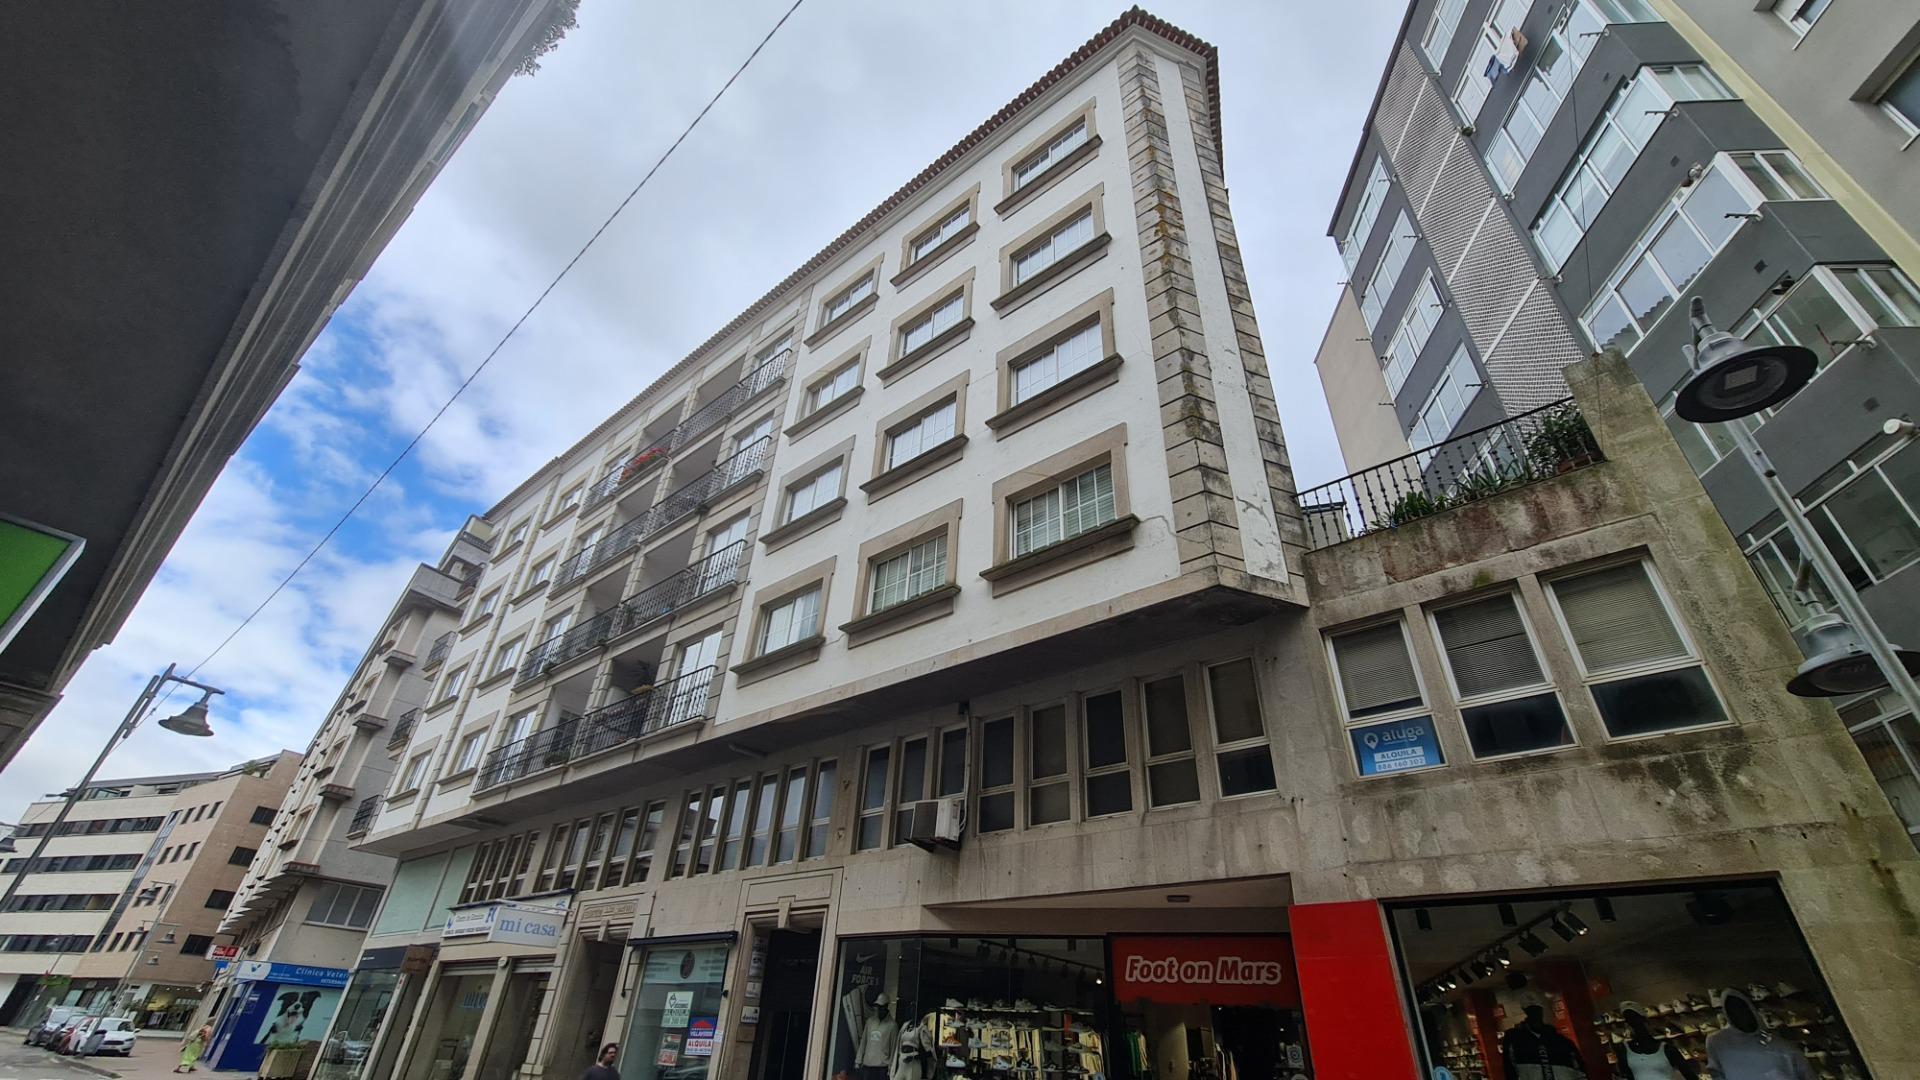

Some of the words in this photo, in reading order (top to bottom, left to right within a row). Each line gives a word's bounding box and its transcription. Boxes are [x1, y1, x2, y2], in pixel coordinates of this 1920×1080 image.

[1382, 725, 1424, 741] aluga
[1381, 748, 1417, 760] ALQUILA
[500, 918, 522, 932] mi
[524, 921, 556, 937] casa
[859, 965, 873, 975] AIR
[1125, 955, 1179, 983] Foot
[1180, 960, 1214, 984] on
[1215, 956, 1283, 985] Mars
[850, 973, 874, 986] FORCE
[687, 1040, 711, 1048] ALQUILA
